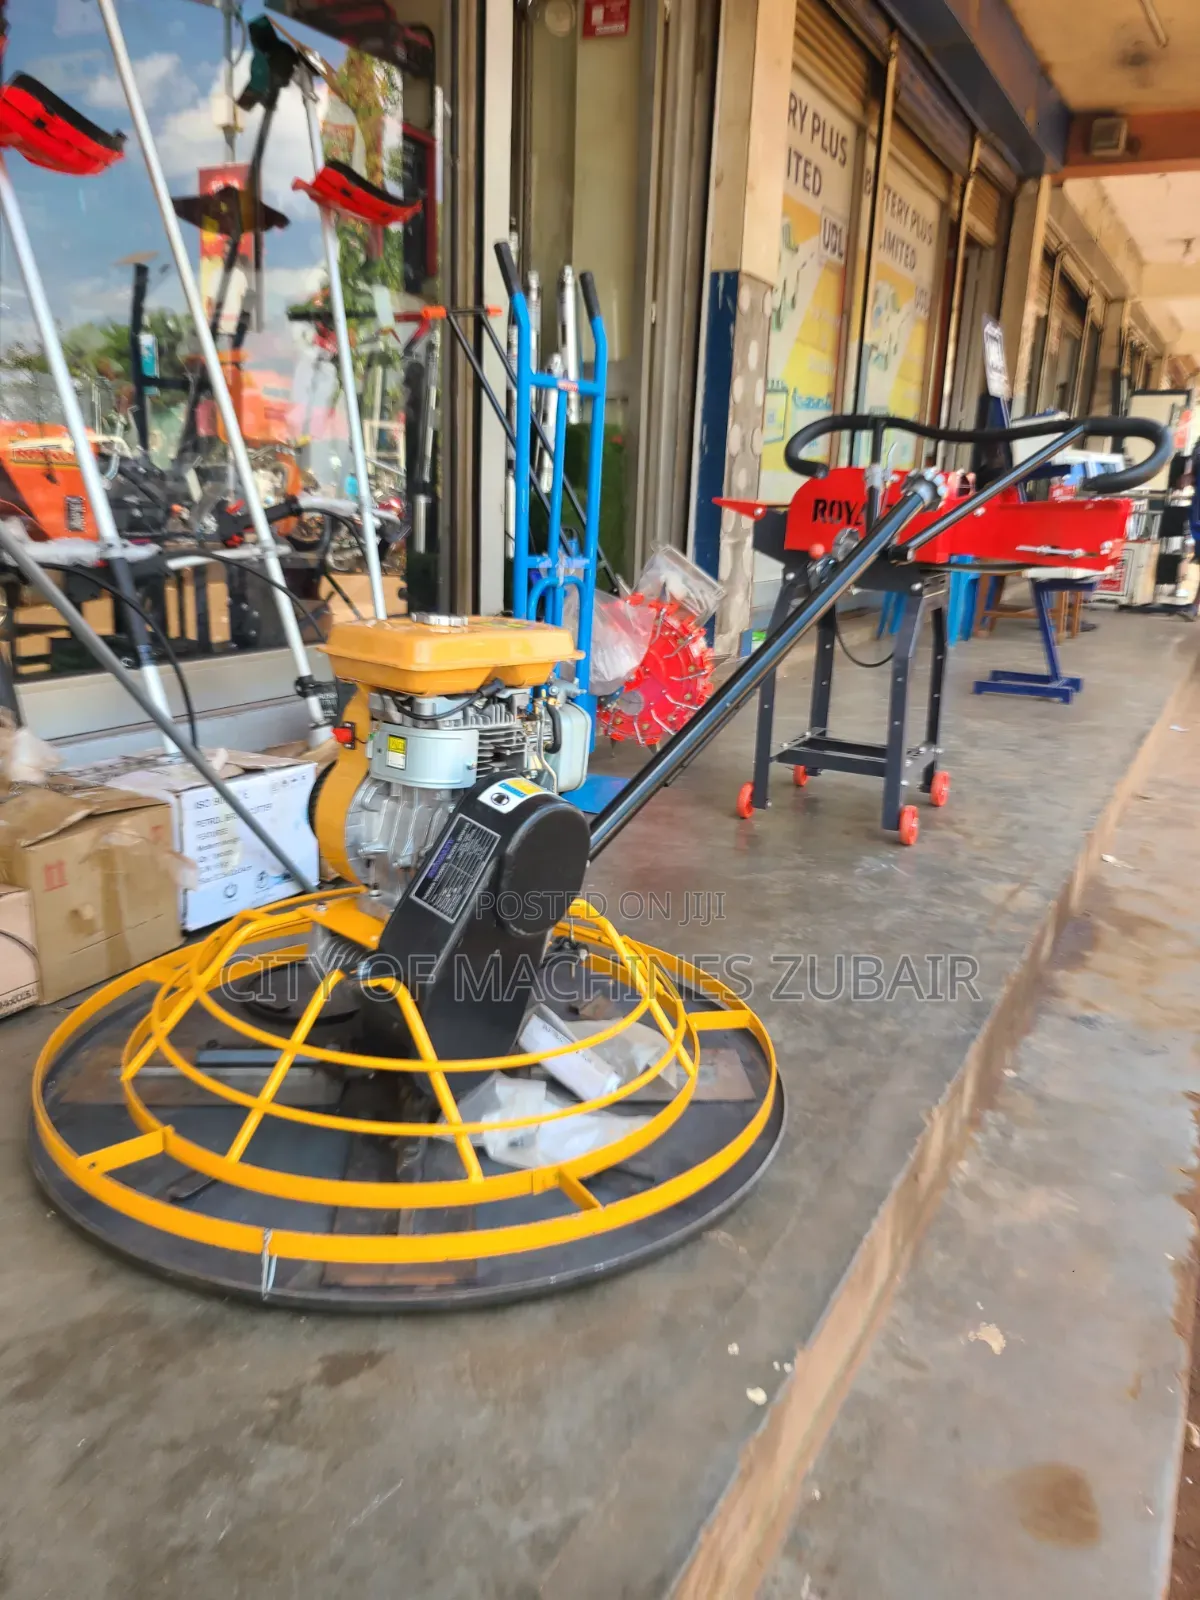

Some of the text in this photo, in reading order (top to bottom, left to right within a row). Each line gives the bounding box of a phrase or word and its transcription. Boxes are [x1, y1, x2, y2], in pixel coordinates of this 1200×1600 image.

[811, 111, 848, 169] PLUS
[879, 227, 917, 272] IMITED
[910, 208, 934, 247] PLUS
